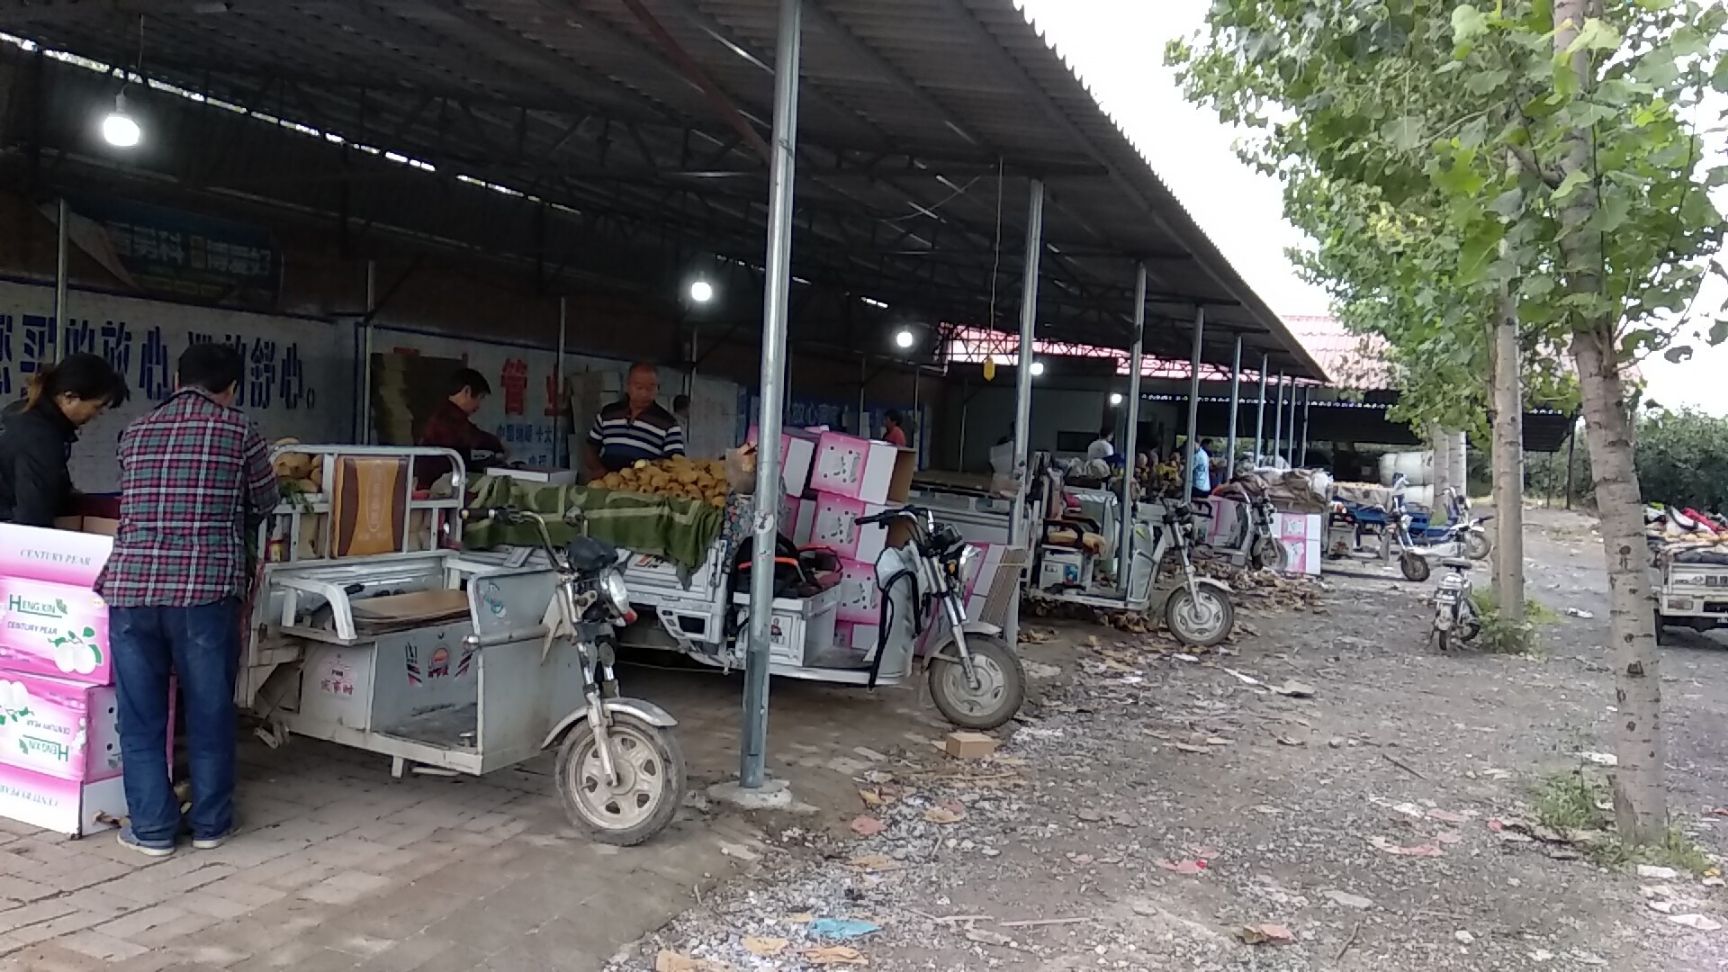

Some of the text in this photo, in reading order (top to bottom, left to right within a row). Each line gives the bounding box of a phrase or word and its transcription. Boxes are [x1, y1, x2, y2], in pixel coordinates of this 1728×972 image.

[20, 549, 91, 566] CENTURY PEAR
[9, 594, 40, 612] HENG
[7, 621, 58, 635] CENTURY PEAR
